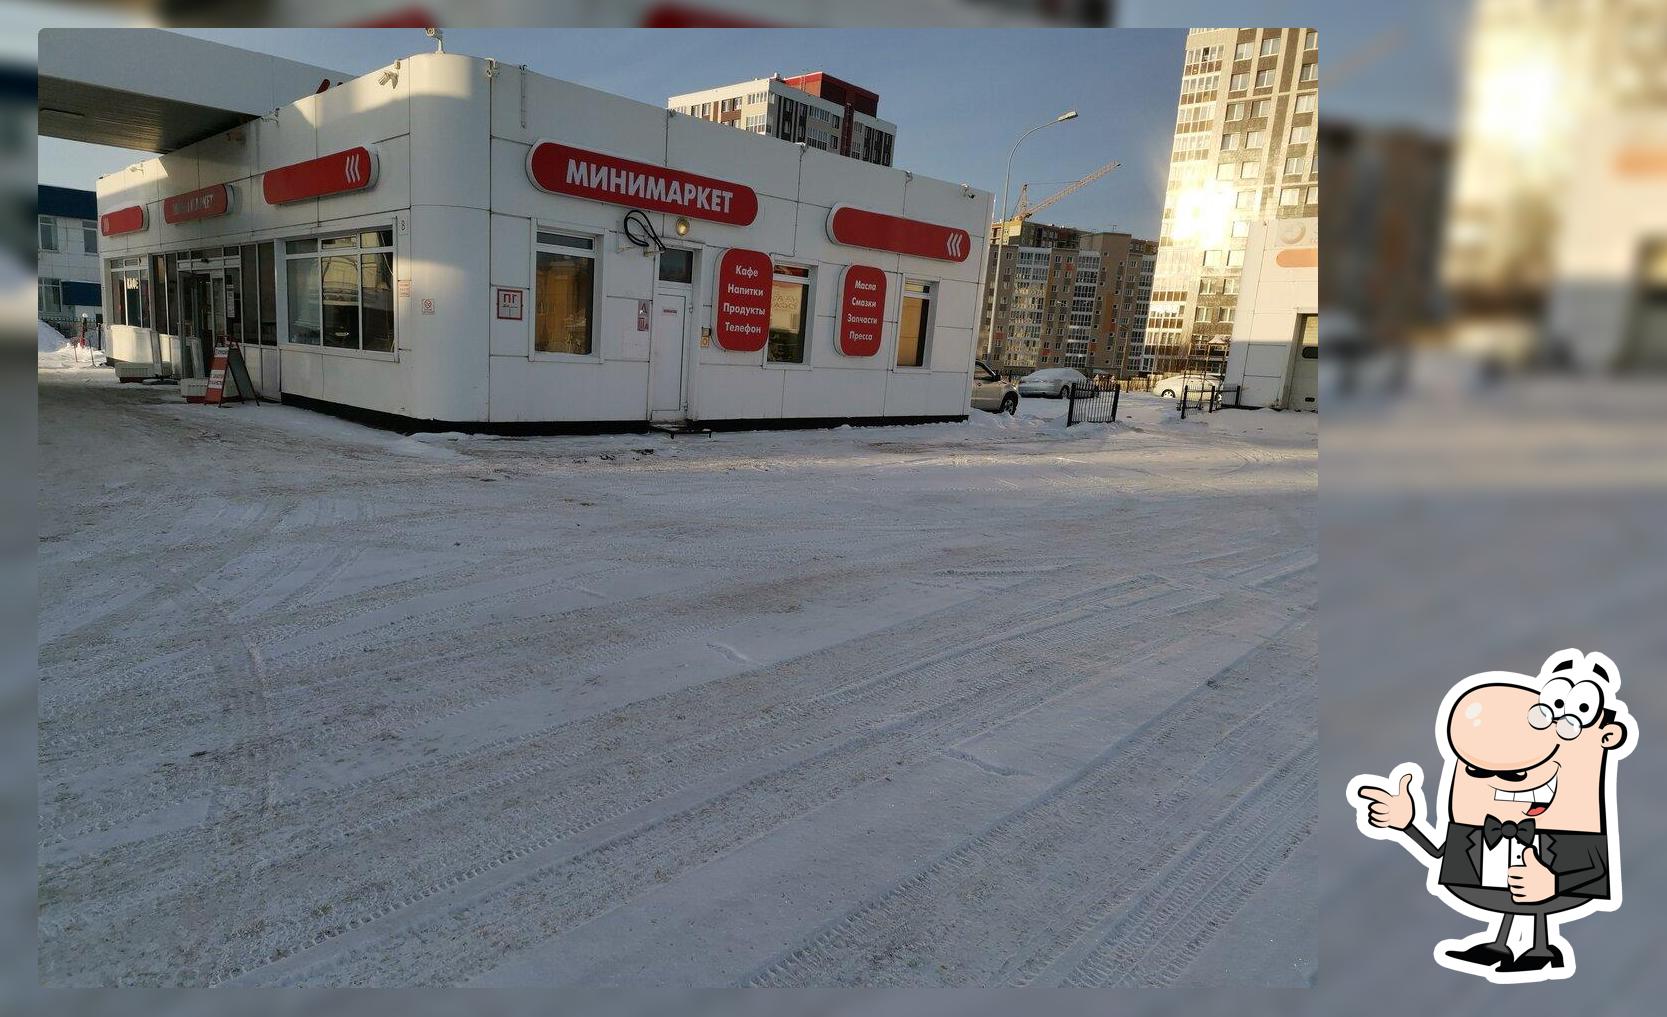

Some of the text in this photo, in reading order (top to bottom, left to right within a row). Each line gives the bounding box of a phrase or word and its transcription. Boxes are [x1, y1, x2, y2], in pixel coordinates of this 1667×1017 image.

[566, 158, 734, 214] МИНИМАРКЕТ
[735, 264, 759, 279] Кафе
[727, 283, 764, 297] Напитки
[855, 279, 877, 291] Масла
[851, 296, 877, 308] Смазки
[723, 302, 766, 317] Продукты
[847, 312, 878, 325] Запчасти
[724, 321, 762, 335] Телефон
[849, 330, 873, 342] Пресса
